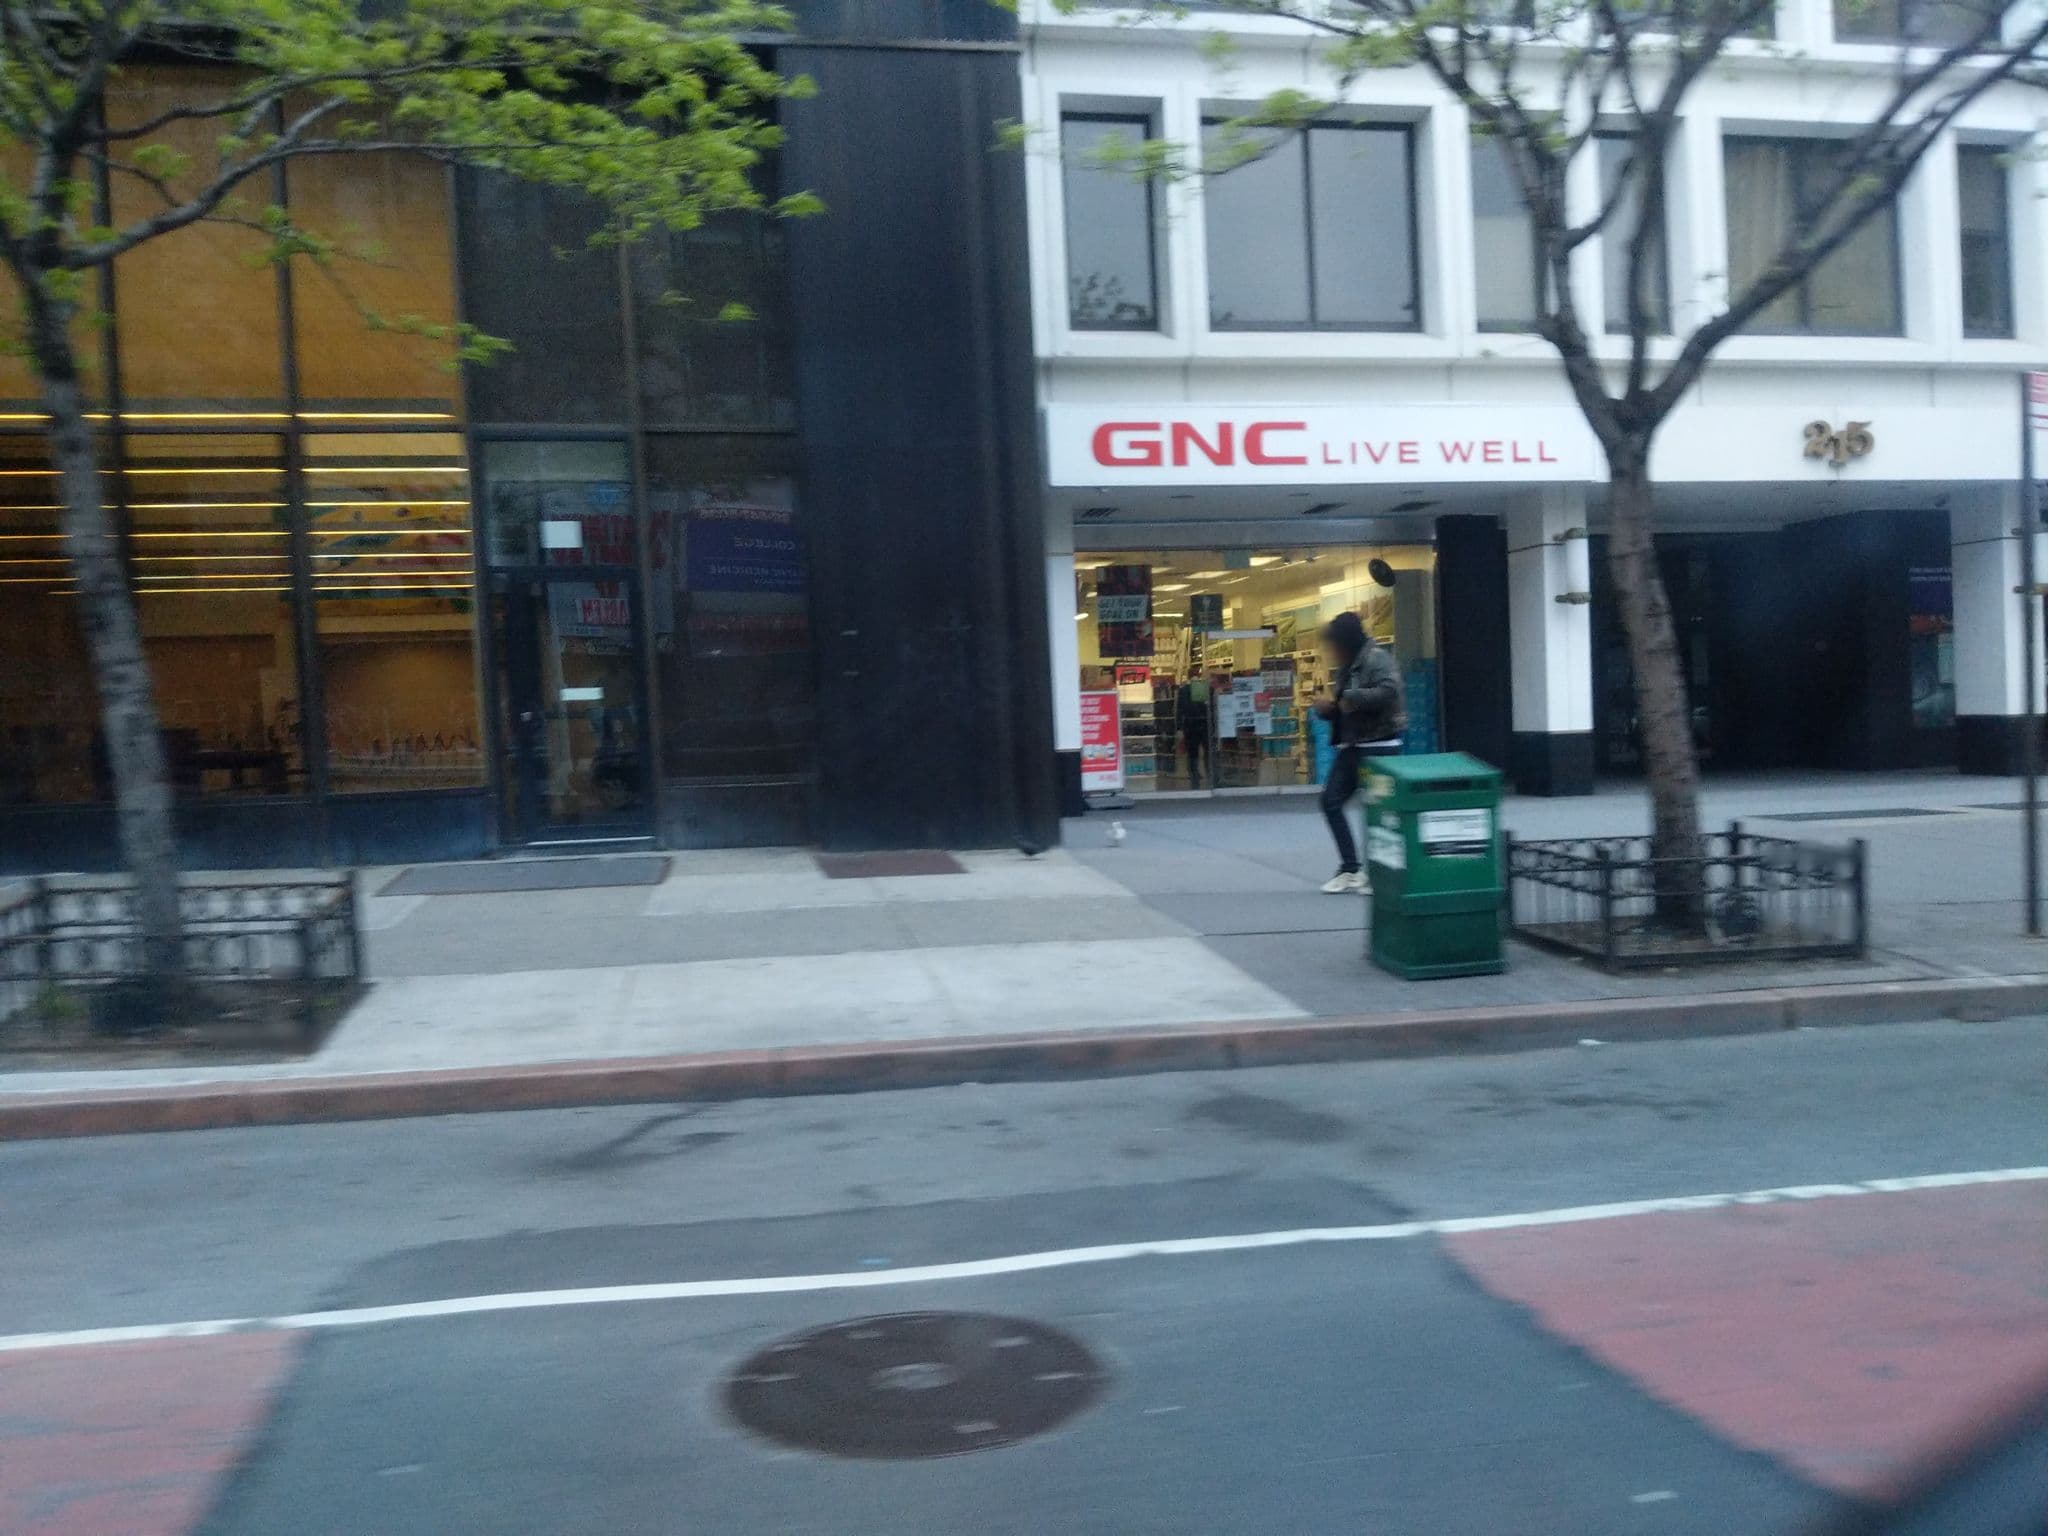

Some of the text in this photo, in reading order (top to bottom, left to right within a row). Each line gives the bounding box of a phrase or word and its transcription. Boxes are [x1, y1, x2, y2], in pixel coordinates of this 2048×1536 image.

[1091, 421, 1558, 467] GNC LIVE WELL
[1803, 420, 1874, 468] 215
